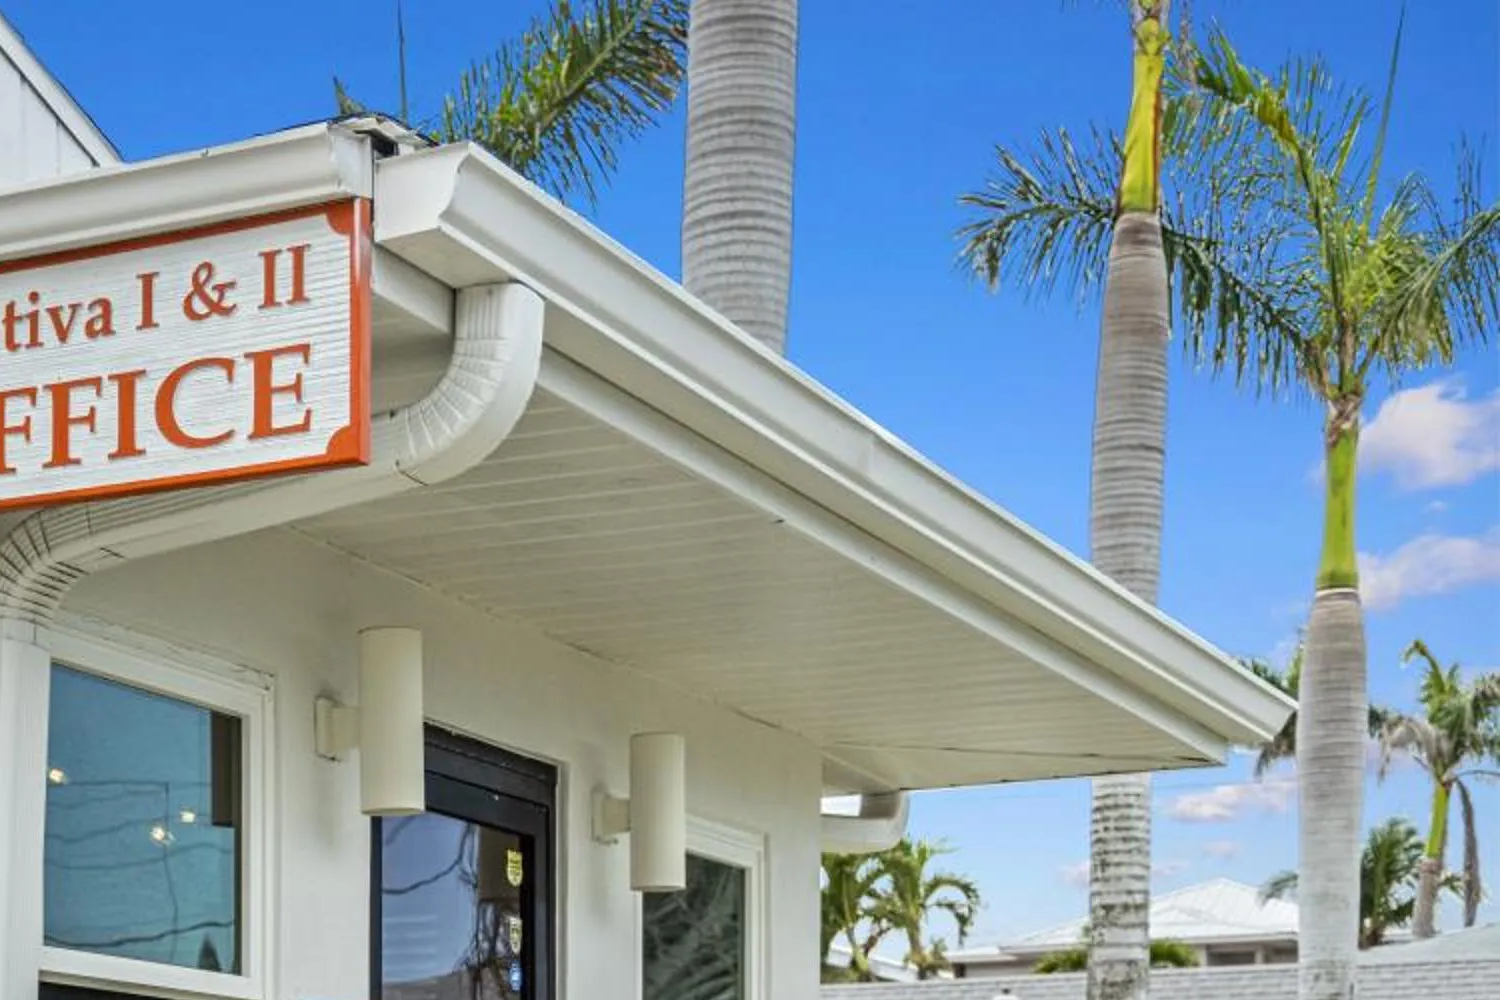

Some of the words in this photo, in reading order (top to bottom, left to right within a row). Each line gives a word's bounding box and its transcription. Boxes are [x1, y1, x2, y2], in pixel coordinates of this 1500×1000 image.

[135, 271, 160, 331] I
[183, 261, 237, 321] &
[257, 244, 312, 309] II
